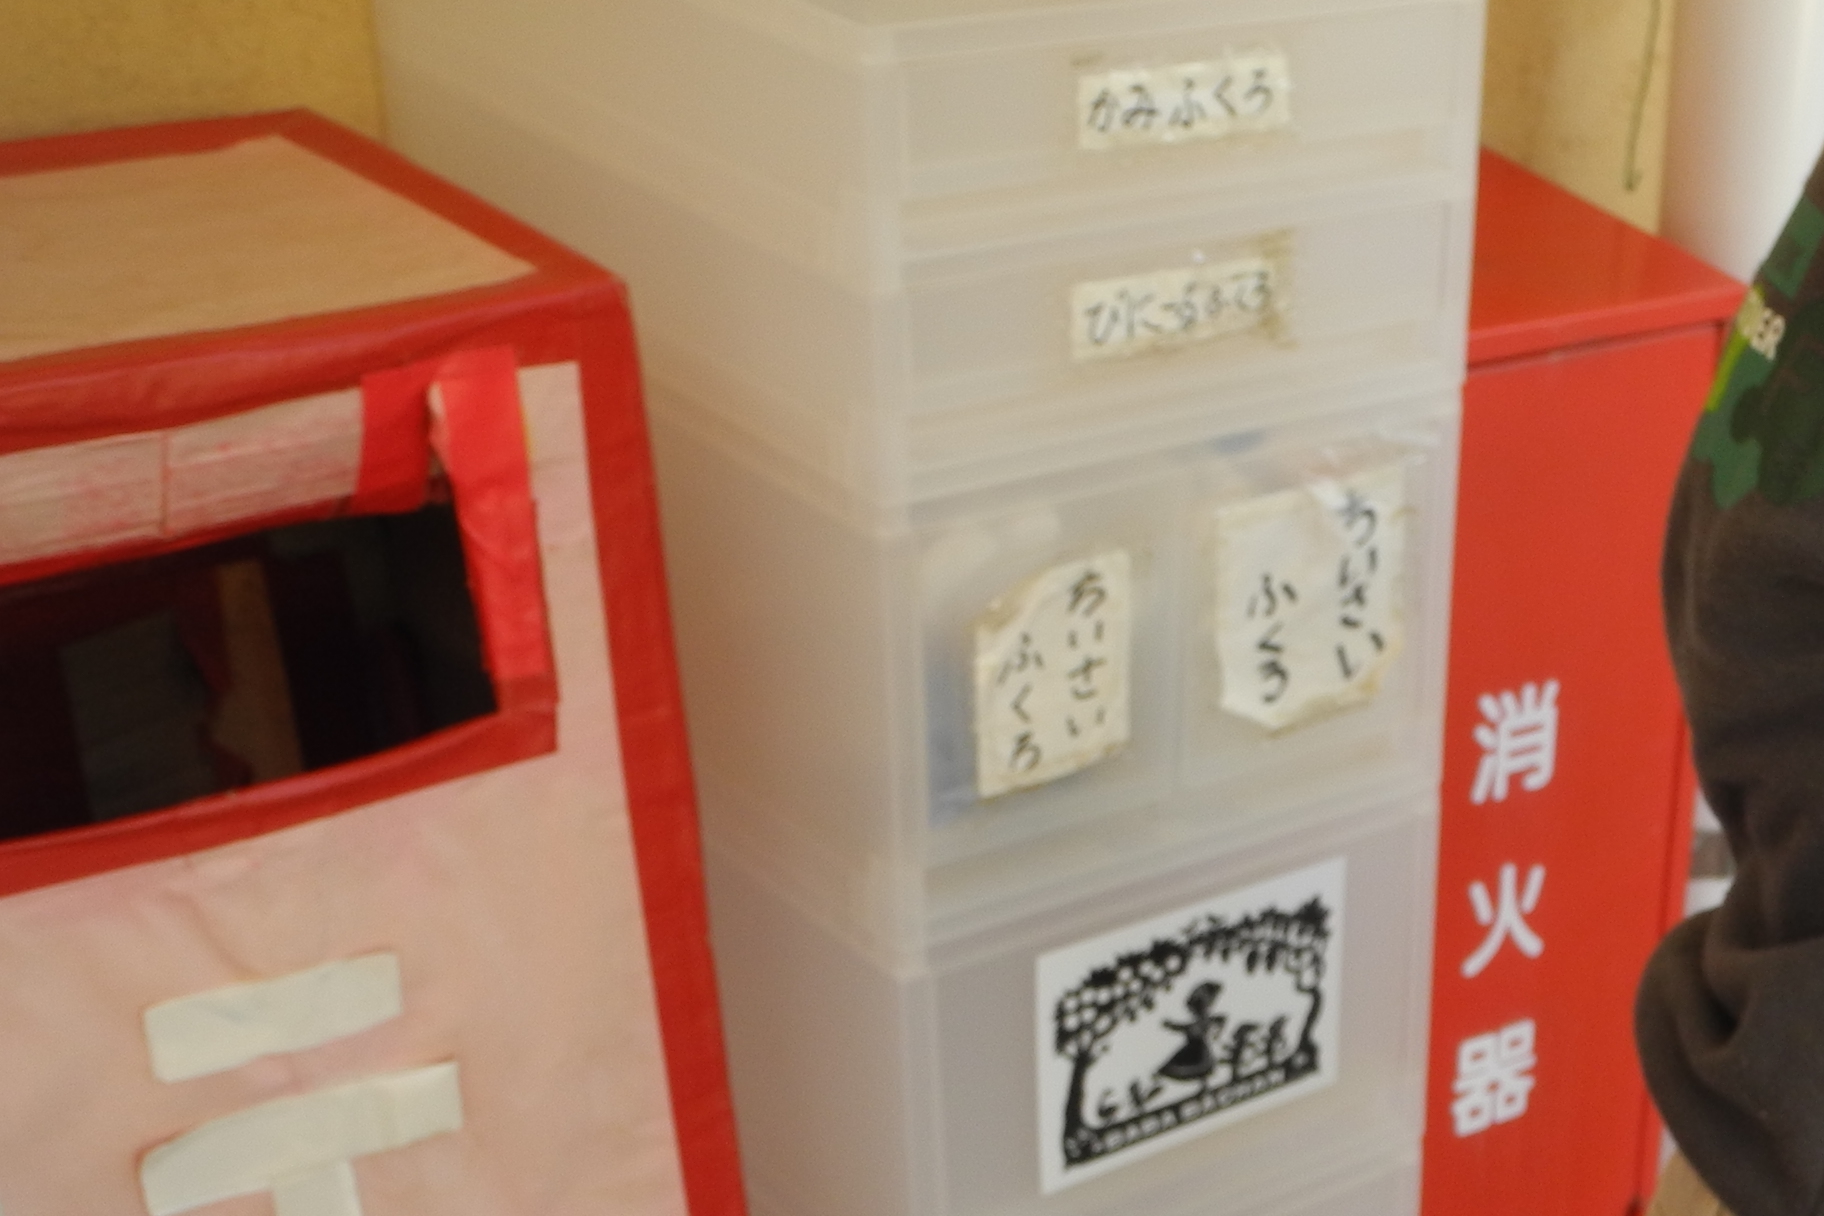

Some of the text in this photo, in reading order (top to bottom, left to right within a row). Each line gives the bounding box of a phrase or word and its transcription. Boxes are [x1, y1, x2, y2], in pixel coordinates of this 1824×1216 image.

[1086, 67, 1275, 133] かみふくろ
[996, 630, 1045, 774] ふくろ
[1064, 568, 1109, 739] ちいさい
[1246, 572, 1299, 703] ふくろ
[1450, 678, 1560, 1138] 消火器
